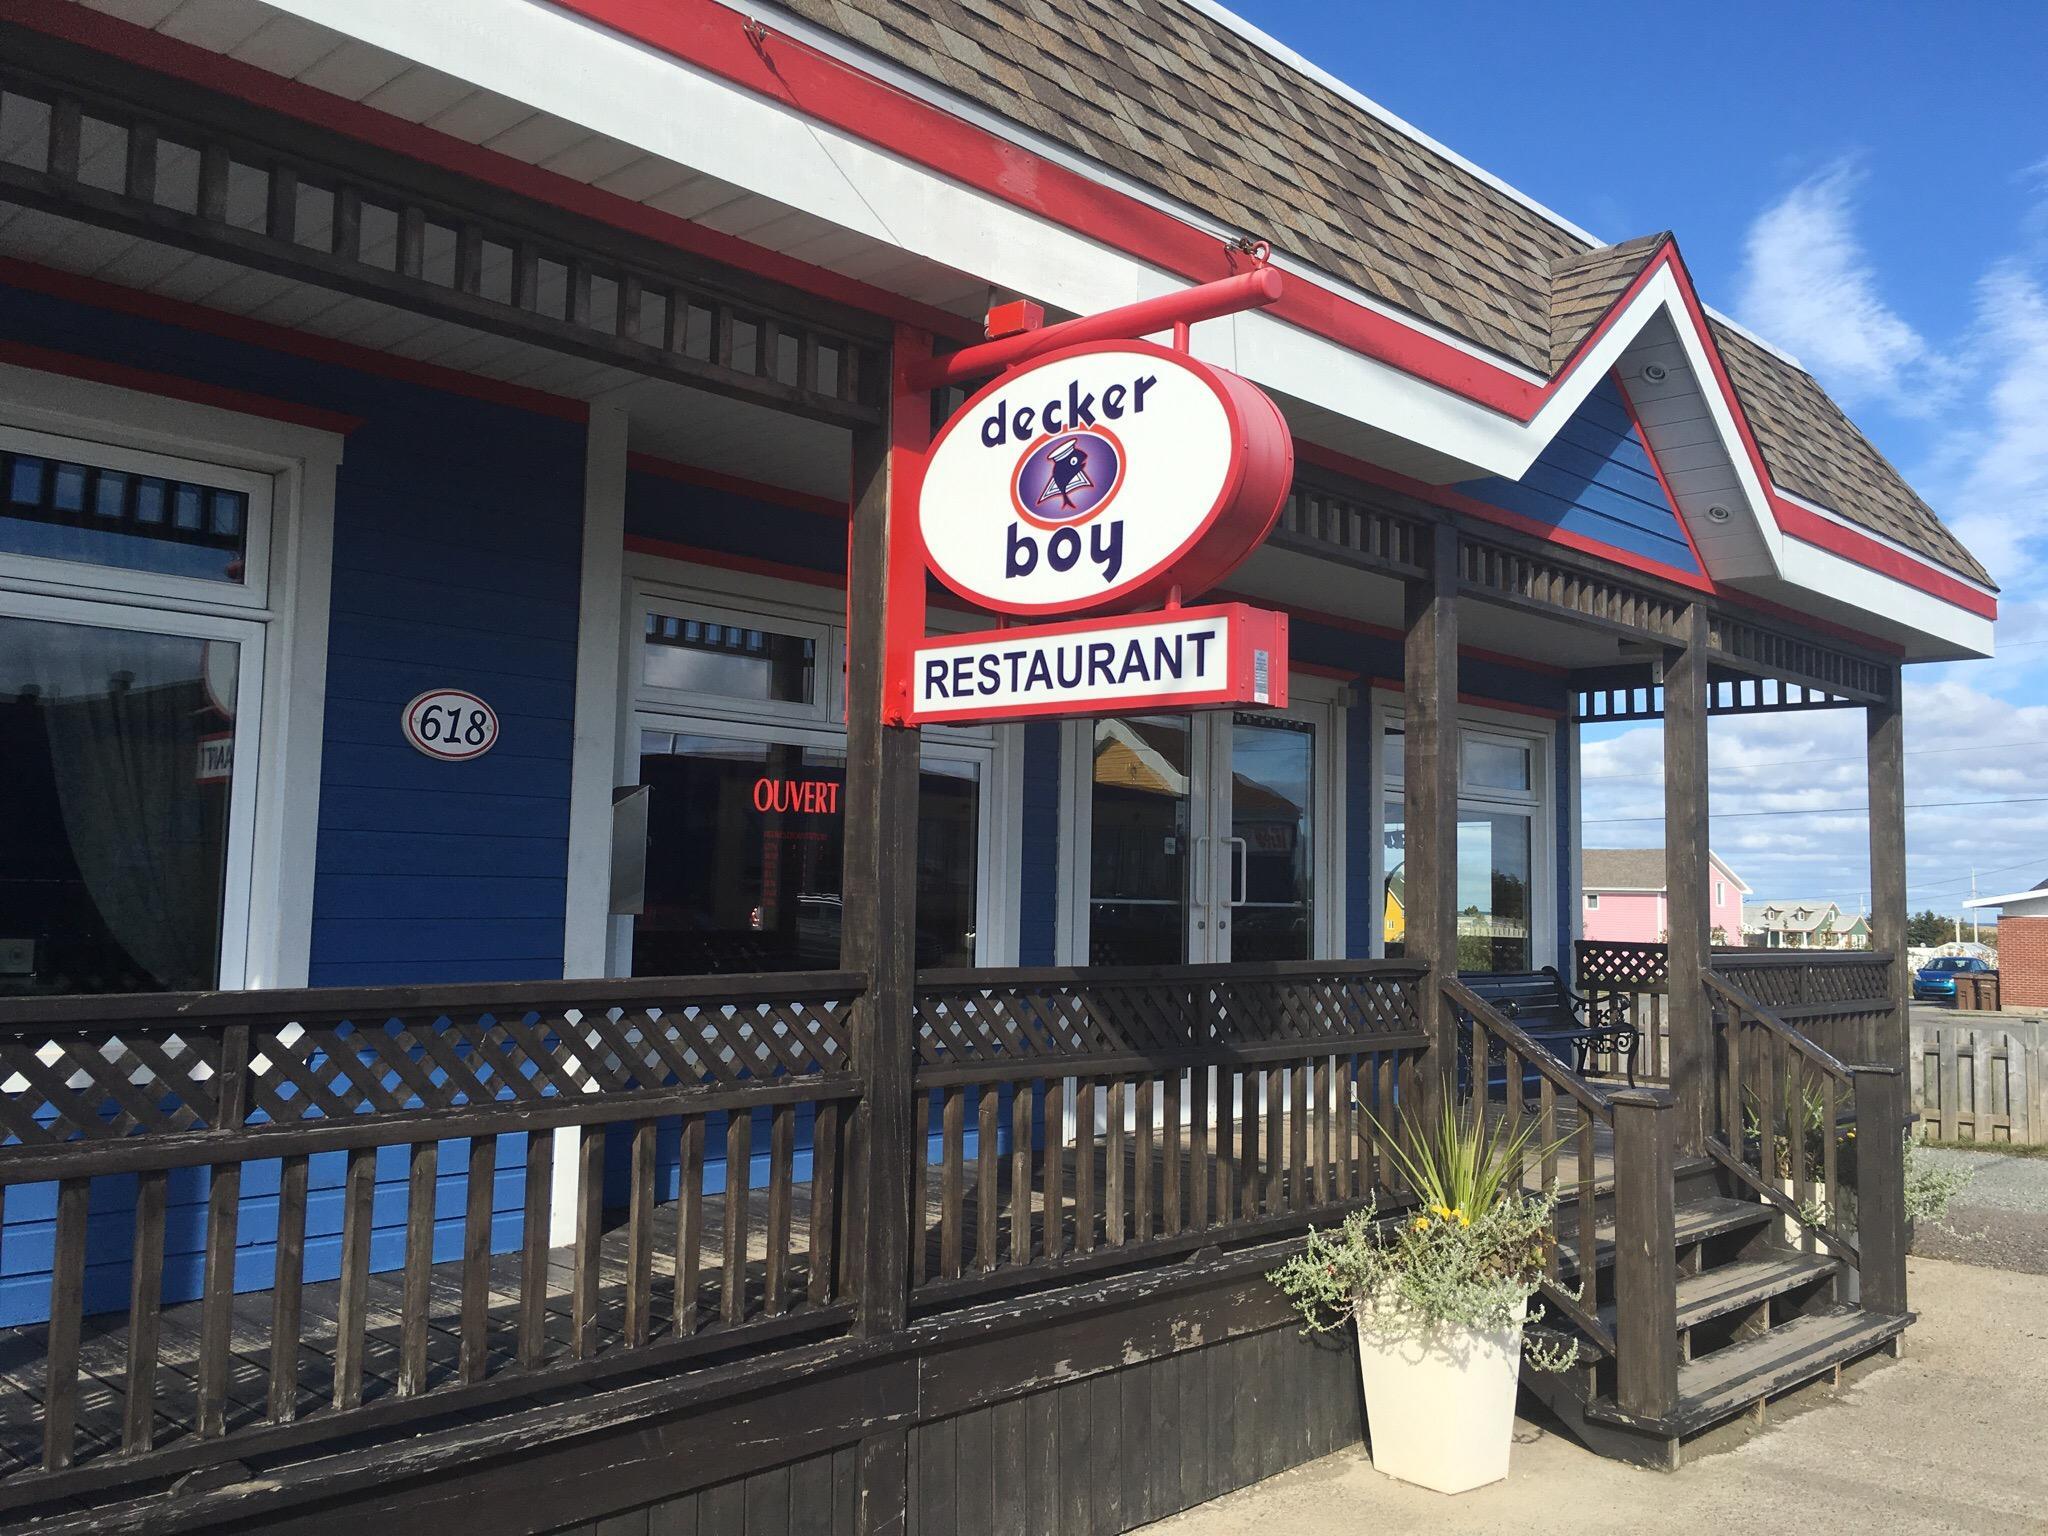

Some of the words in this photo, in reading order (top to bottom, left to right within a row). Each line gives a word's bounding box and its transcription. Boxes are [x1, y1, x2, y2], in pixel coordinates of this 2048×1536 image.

[981, 375, 1157, 448] decker
[1005, 520, 1124, 583] boy
[925, 631, 1215, 699] RESTAURANT
[420, 704, 487, 745] 618
[753, 778, 839, 814] OUVERT
